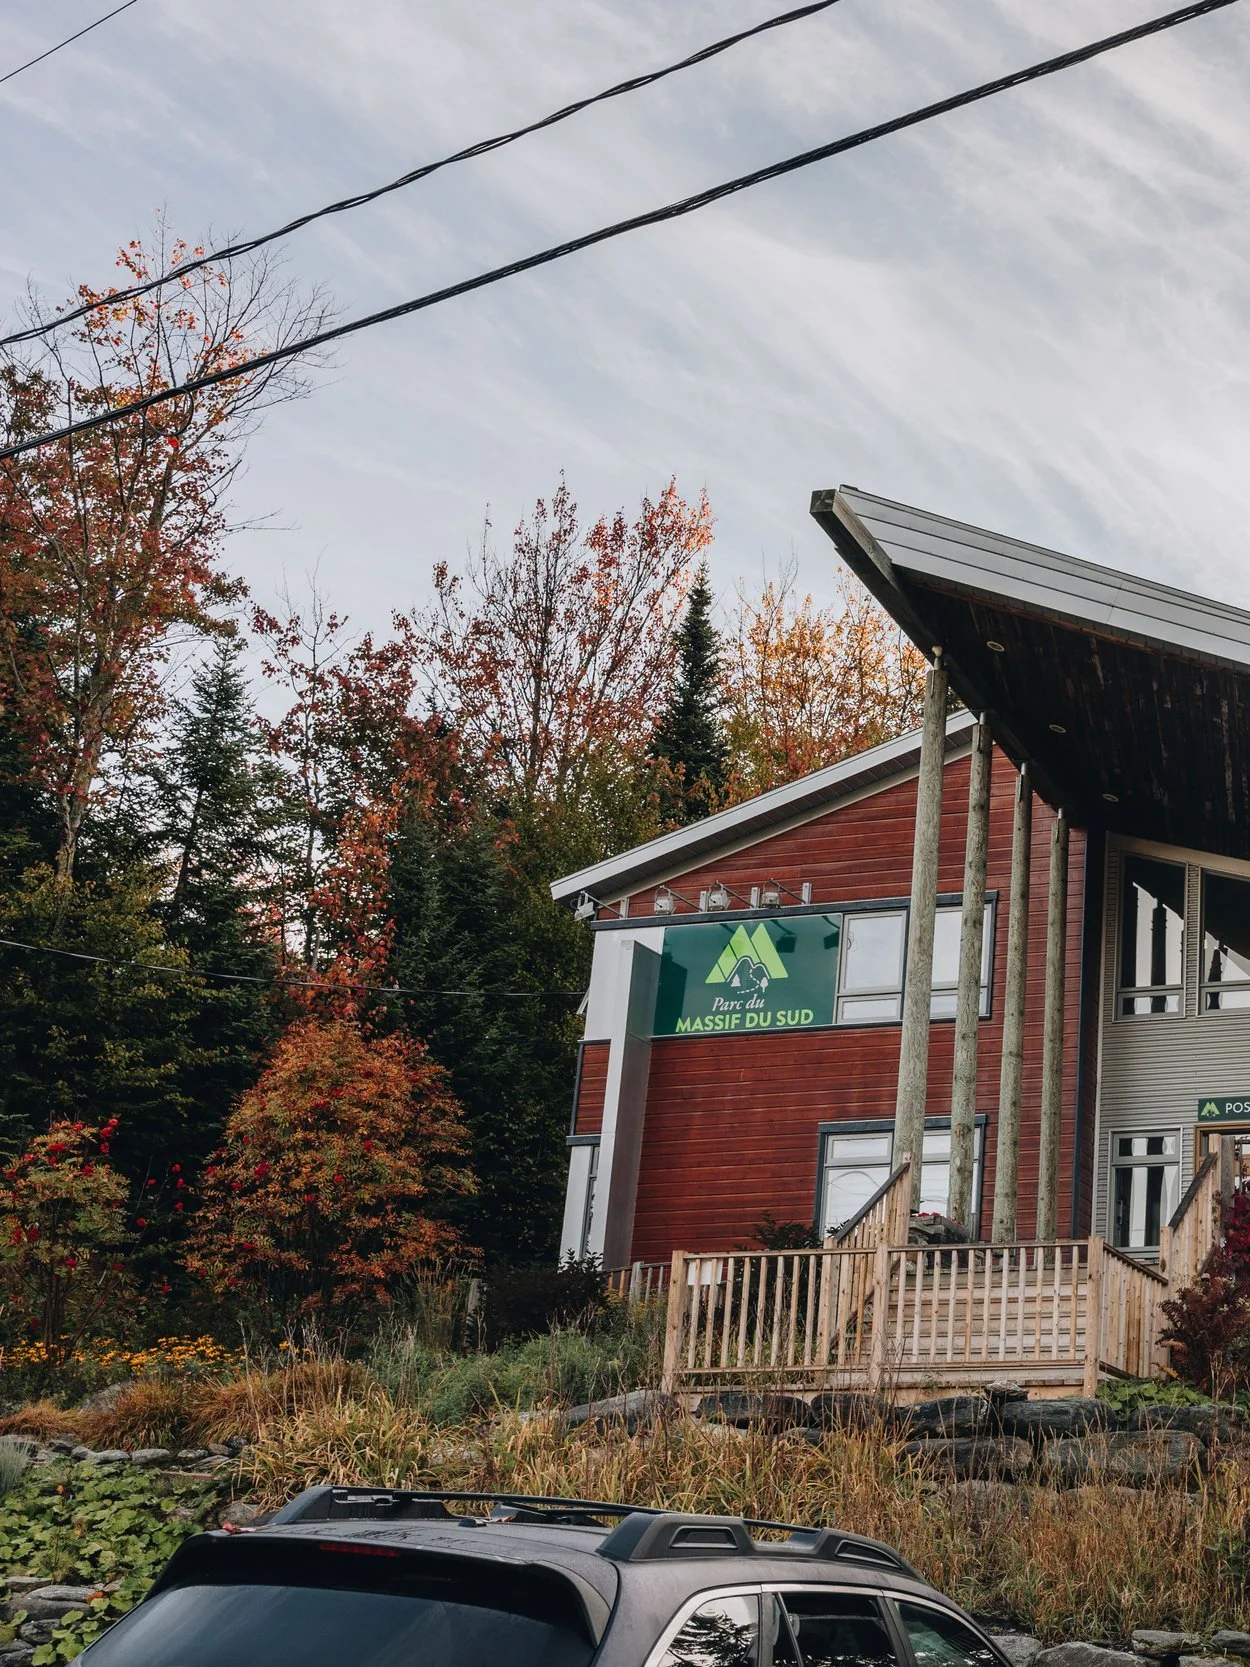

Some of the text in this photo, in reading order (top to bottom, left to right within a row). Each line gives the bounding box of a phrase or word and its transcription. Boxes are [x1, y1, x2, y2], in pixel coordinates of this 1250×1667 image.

[712, 994, 765, 1012] Parc du
[675, 1009, 814, 1033] MASSIF DU SUD
